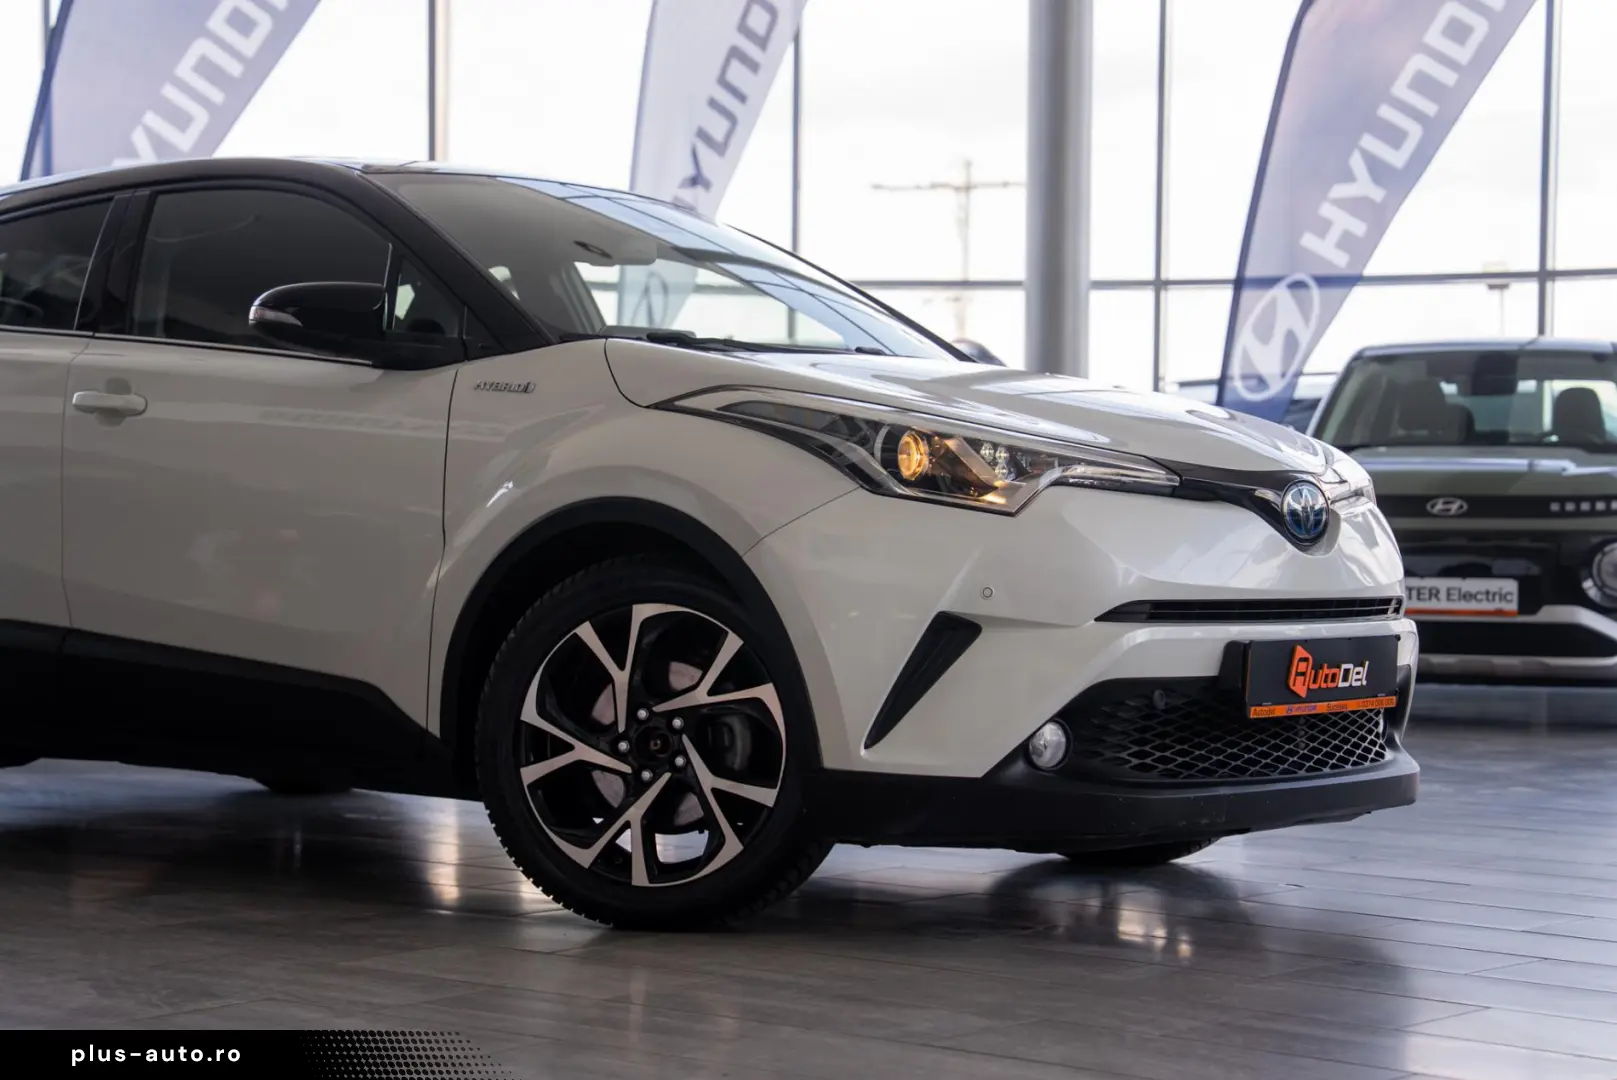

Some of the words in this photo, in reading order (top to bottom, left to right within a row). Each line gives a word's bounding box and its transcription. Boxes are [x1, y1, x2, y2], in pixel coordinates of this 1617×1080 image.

[110, 0, 288, 167] YUND
[1300, 0, 1507, 268] HYUND
[1446, 586, 1514, 604] Electric
[1289, 646, 1369, 697] AutoDel
